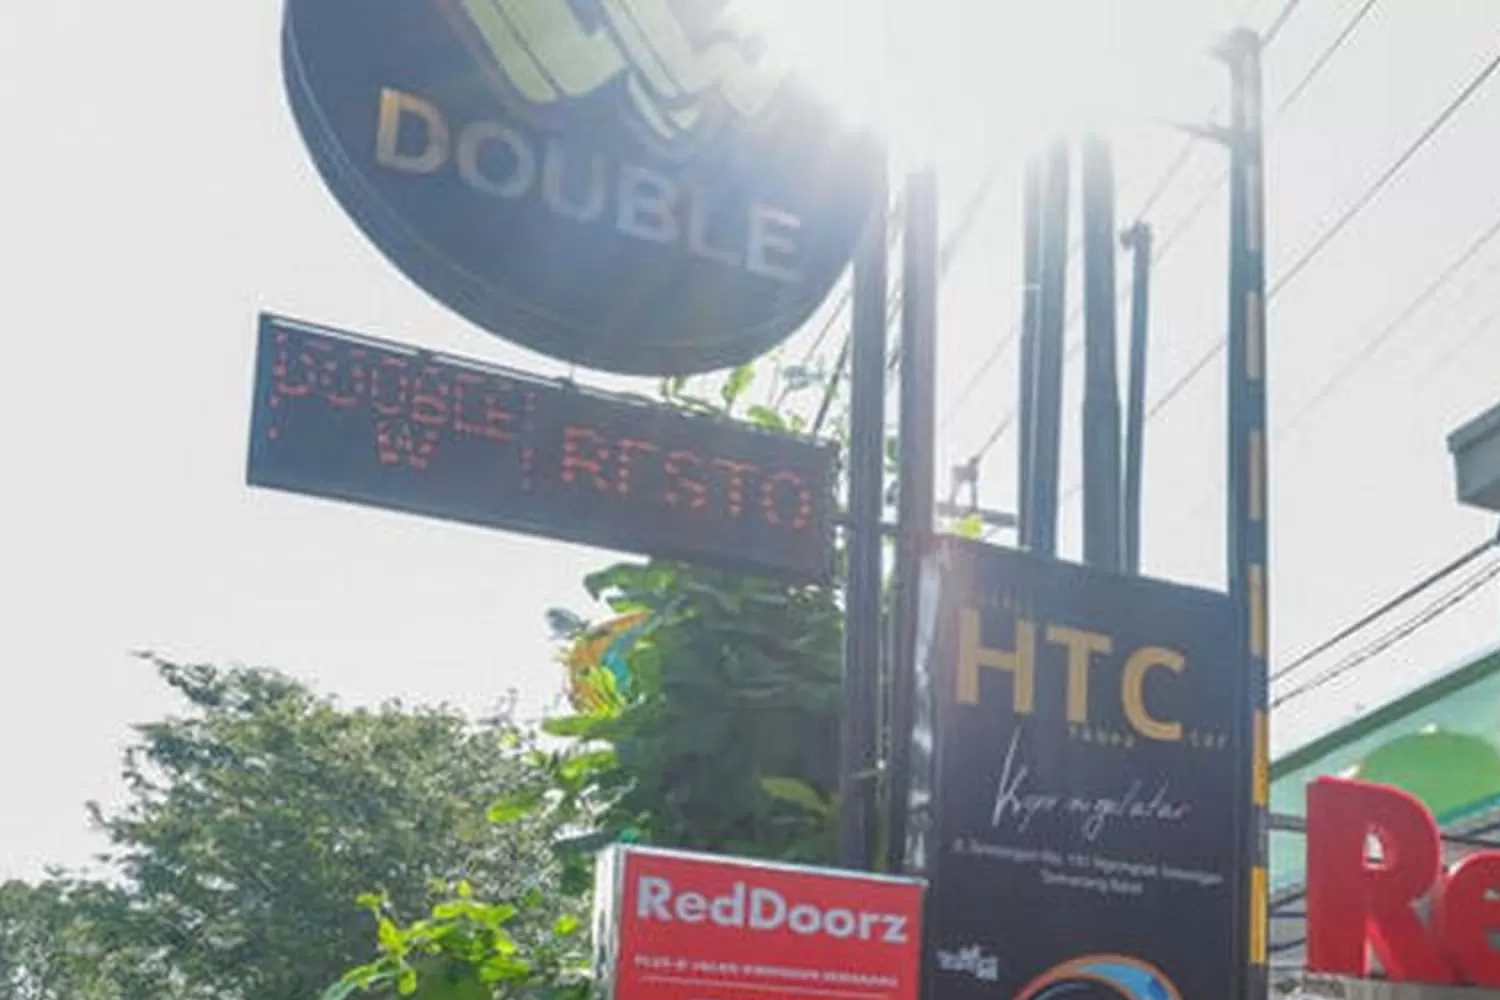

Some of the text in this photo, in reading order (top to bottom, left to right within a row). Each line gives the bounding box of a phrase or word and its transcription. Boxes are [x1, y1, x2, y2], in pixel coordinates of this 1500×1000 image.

[374, 86, 802, 283] DOUBLE
[955, 606, 1186, 742] HTC
[635, 875, 909, 944] RedDoorz
